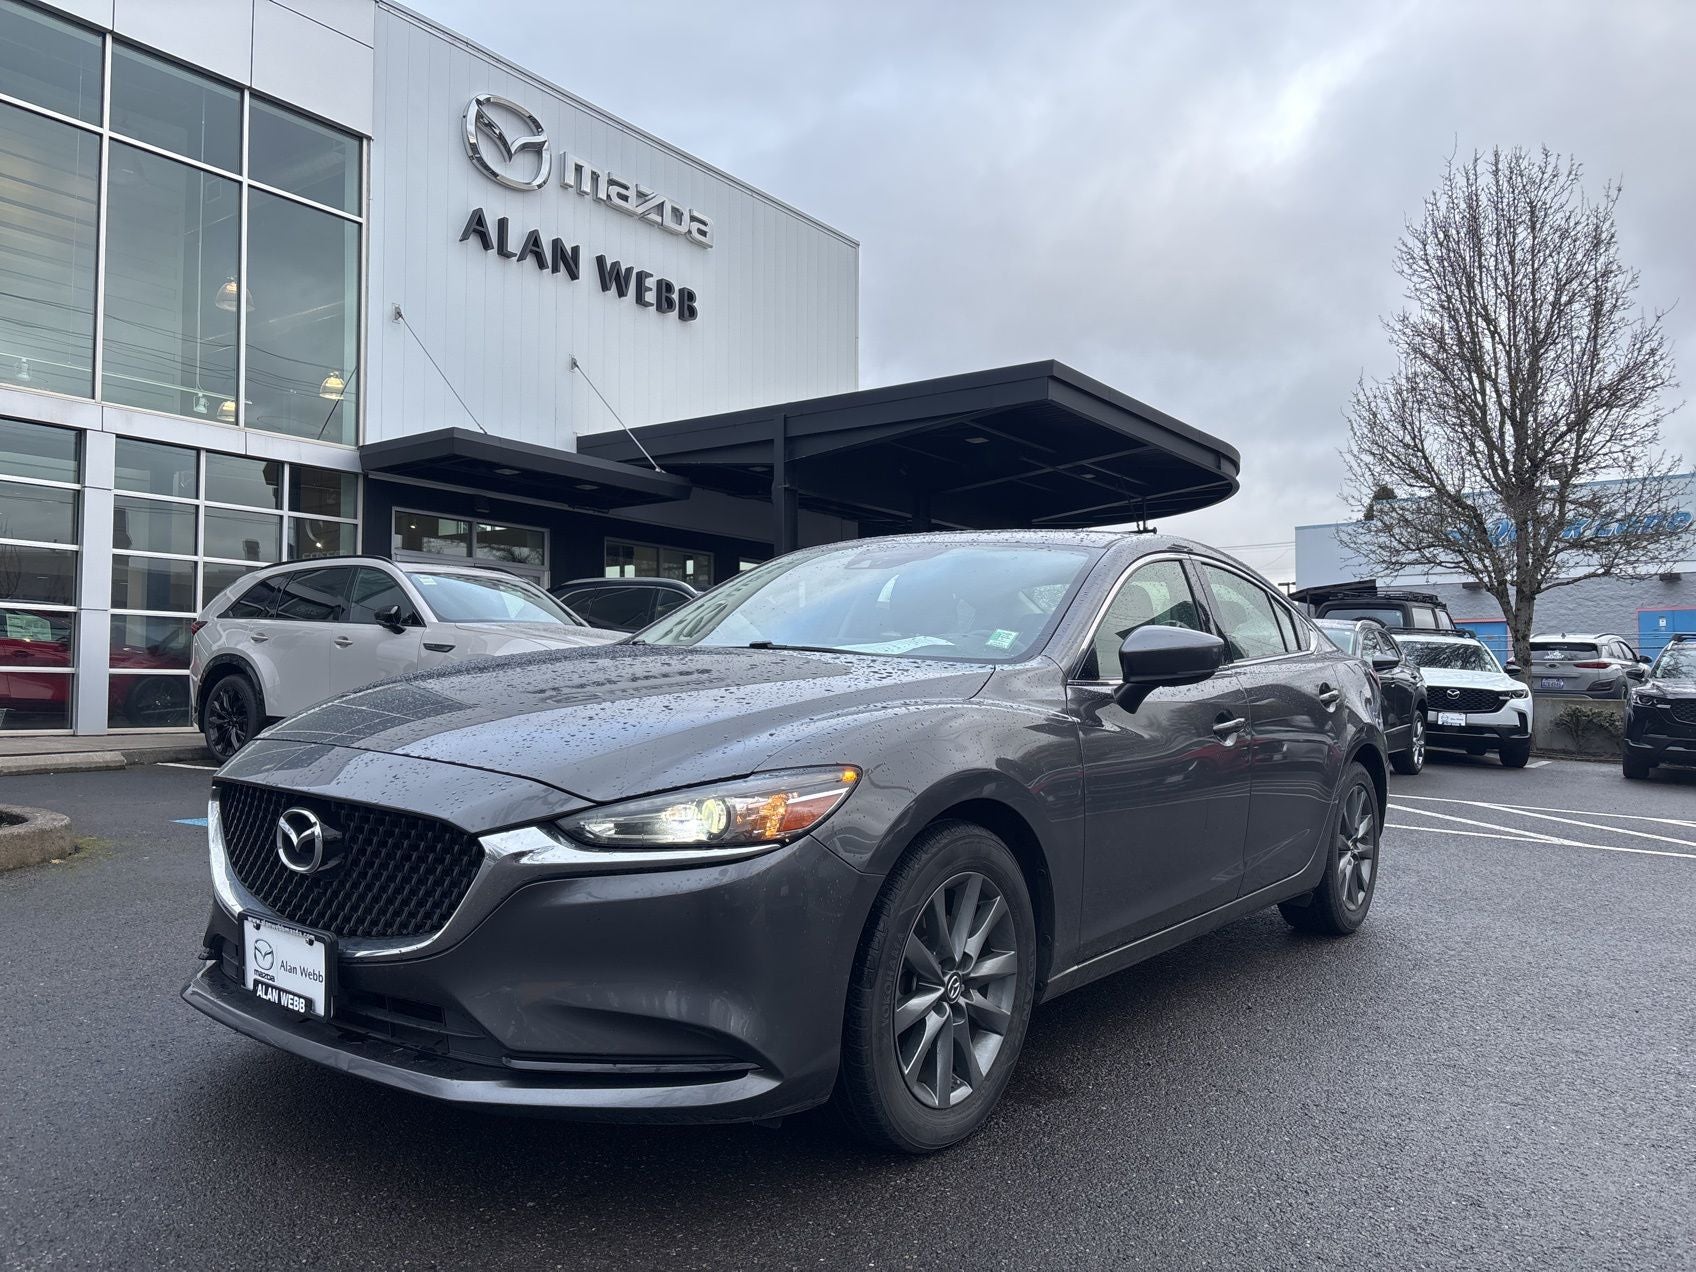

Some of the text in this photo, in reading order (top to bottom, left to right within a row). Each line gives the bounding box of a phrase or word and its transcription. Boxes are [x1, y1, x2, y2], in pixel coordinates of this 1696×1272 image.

[560, 151, 714, 248] mazda
[459, 207, 698, 322] ALAN WEBB
[254, 969, 276, 983] mazda
[280, 960, 324, 983] Alan Webb
[256, 983, 306, 1013] ALAN WEBB
